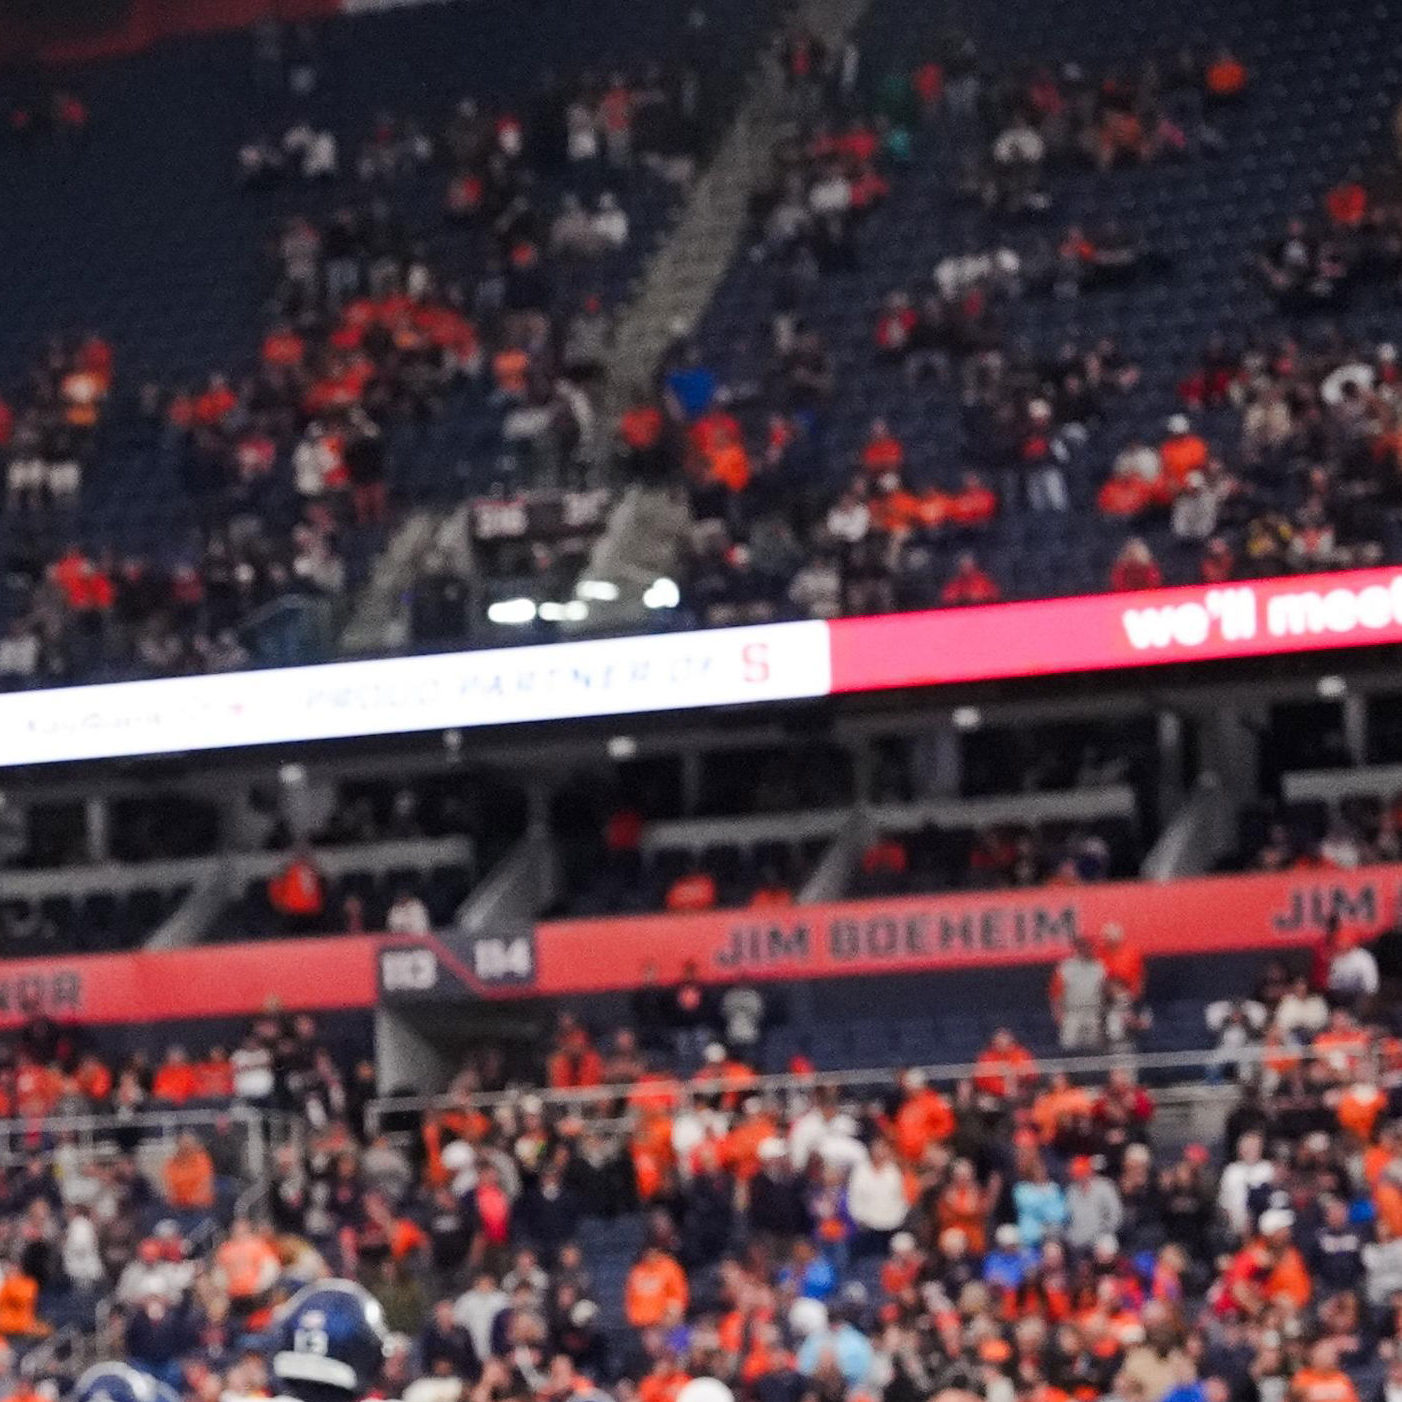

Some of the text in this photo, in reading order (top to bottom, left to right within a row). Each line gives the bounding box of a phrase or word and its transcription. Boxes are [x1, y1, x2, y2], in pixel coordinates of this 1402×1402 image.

[1122, 587, 1256, 649] we'll
[458, 658, 650, 696] PARTNER
[741, 643, 770, 684] S
[714, 905, 1078, 969] JIM BOEHEIM
[1270, 886, 1377, 933] JIM
